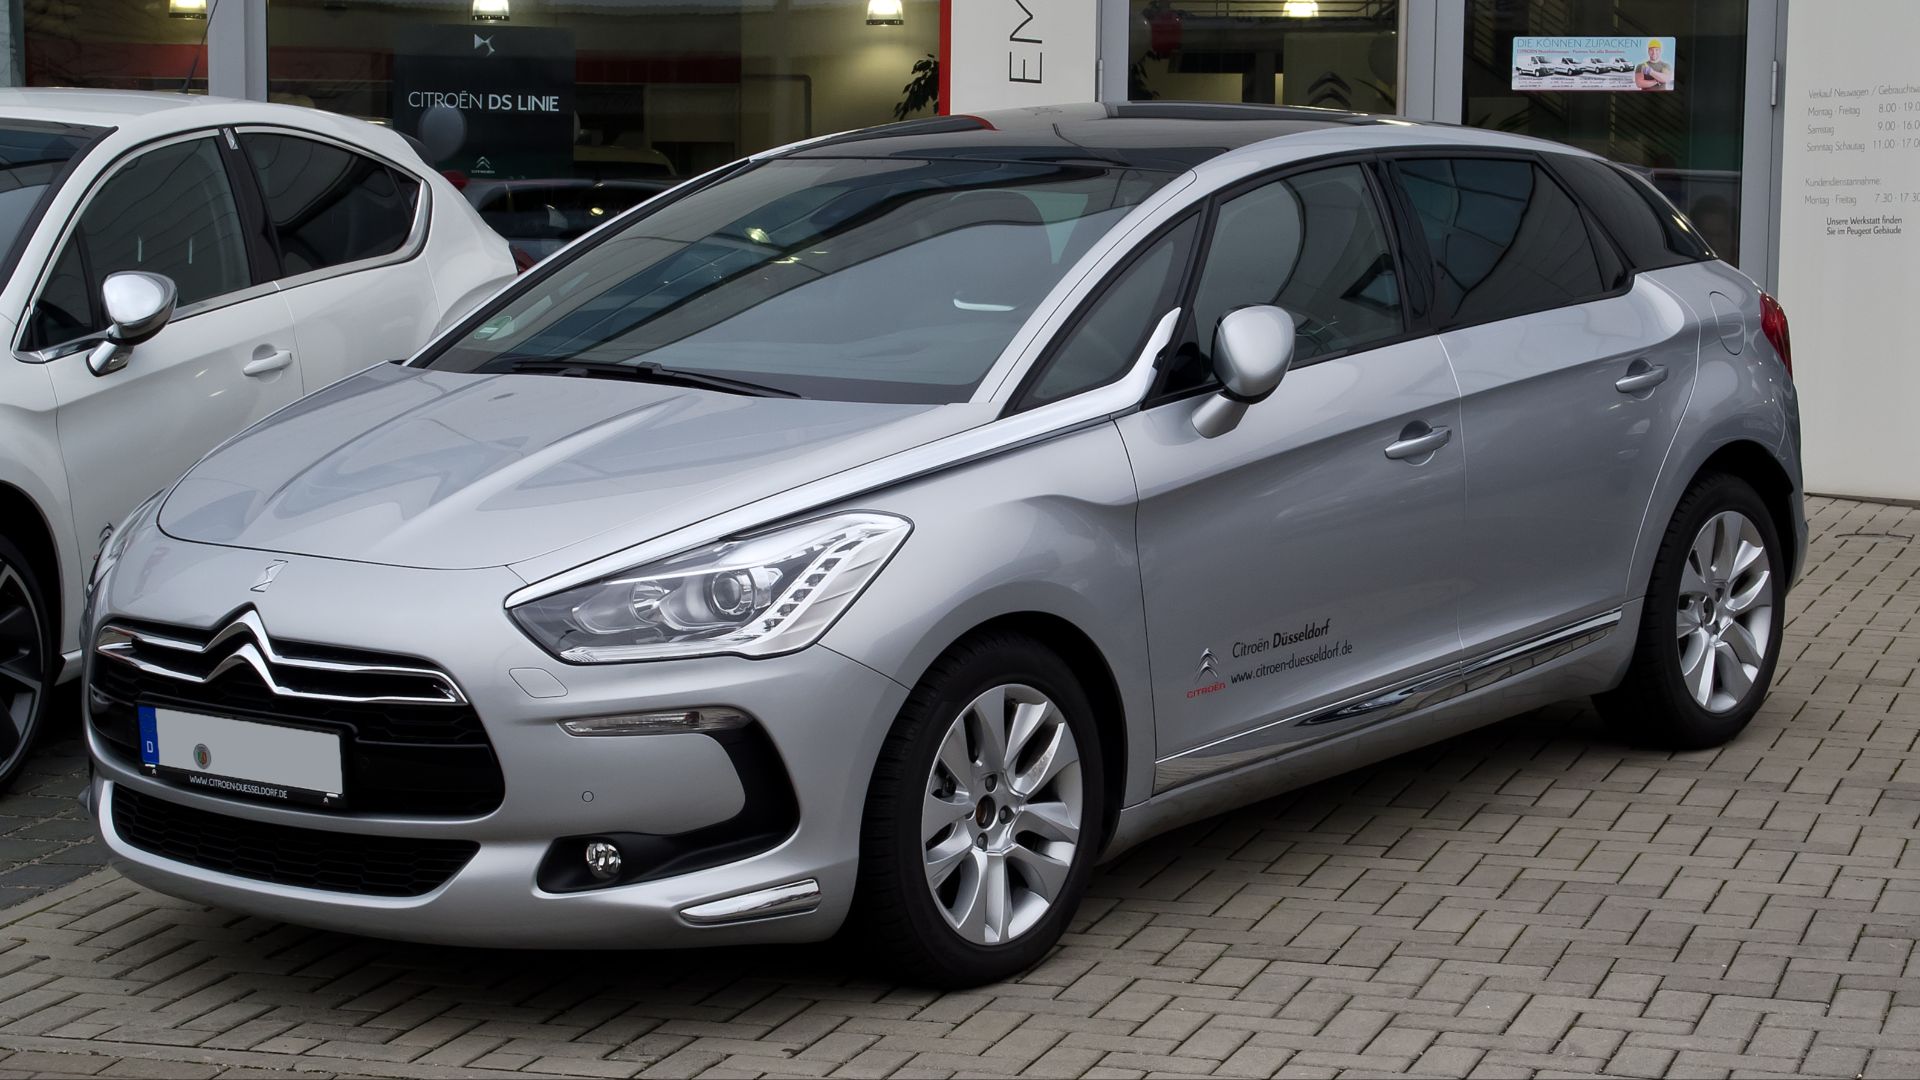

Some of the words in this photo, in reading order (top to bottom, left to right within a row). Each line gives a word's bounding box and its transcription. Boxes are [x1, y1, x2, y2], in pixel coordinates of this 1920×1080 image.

[1517, 39, 1535, 48] DIE
[1536, 38, 1582, 48] KÖNNEN
[1584, 38, 1642, 48] ZUPACKEN!
[1808, 88, 1833, 99] Verkauf
[1834, 88, 1869, 99] Neuwagen
[408, 91, 483, 110] CITROËN
[488, 94, 512, 110] DS
[518, 95, 559, 112] LINIE
[1808, 106, 1833, 118] Montag
[1839, 105, 1861, 117] Freitag
[1878, 103, 1897, 113] 8.00
[1807, 124, 1835, 136] Samstag
[1877, 121, 1896, 131] 9.00
[1903, 120, 1920, 130] 16.0
[1806, 142, 1833, 153] Sonntag
[1873, 139, 1896, 149] 11.00
[1804, 195, 1830, 207] Montag
[1835, 194, 1857, 206] Freitag
[1875, 193, 1893, 203] 7.30
[1826, 217, 1849, 225] Unsere
[1850, 216, 1880, 225] Werkstatt
[1881, 215, 1903, 224] finden
[1826, 227, 1836, 236] Sie
[1837, 227, 1846, 235] im
[1846, 226, 1872, 237] Peugeot
[1873, 225, 1902, 235] Gebäude
[1232, 638, 1270, 658] Citroën
[1272, 618, 1331, 649] Düsseldorf
[1230, 640, 1353, 684] www.citroen-duesseldorf.de
[146, 740, 154, 753] D
[189, 775, 288, 798] WWW.CITROEN-DUESSELDORF.DE
